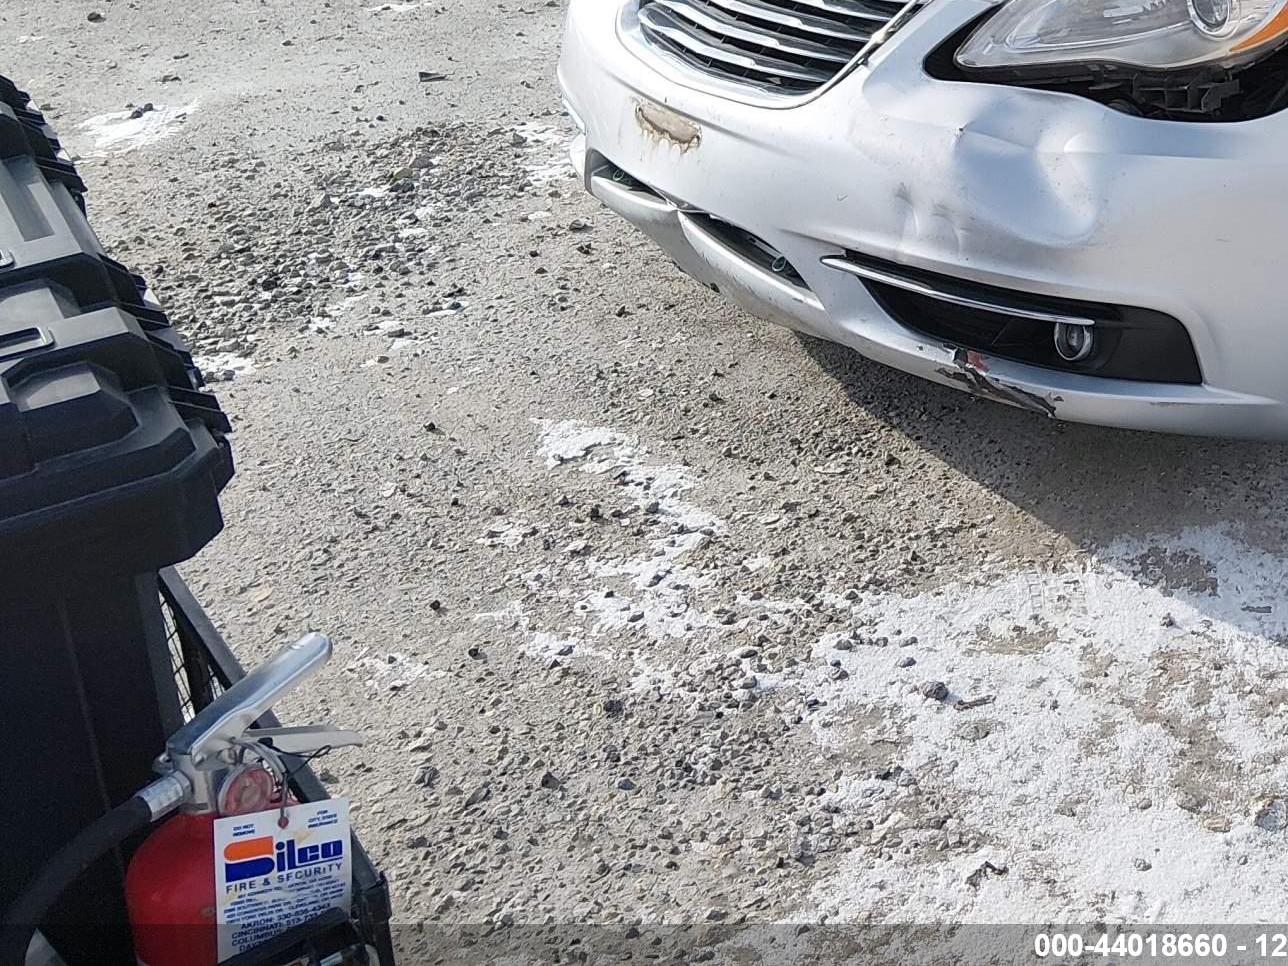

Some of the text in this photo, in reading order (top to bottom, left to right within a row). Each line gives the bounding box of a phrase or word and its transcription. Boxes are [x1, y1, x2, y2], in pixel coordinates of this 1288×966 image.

[224, 836, 343, 883] Silco
[226, 880, 257, 894] FIRE
[262, 877, 271, 886] &
